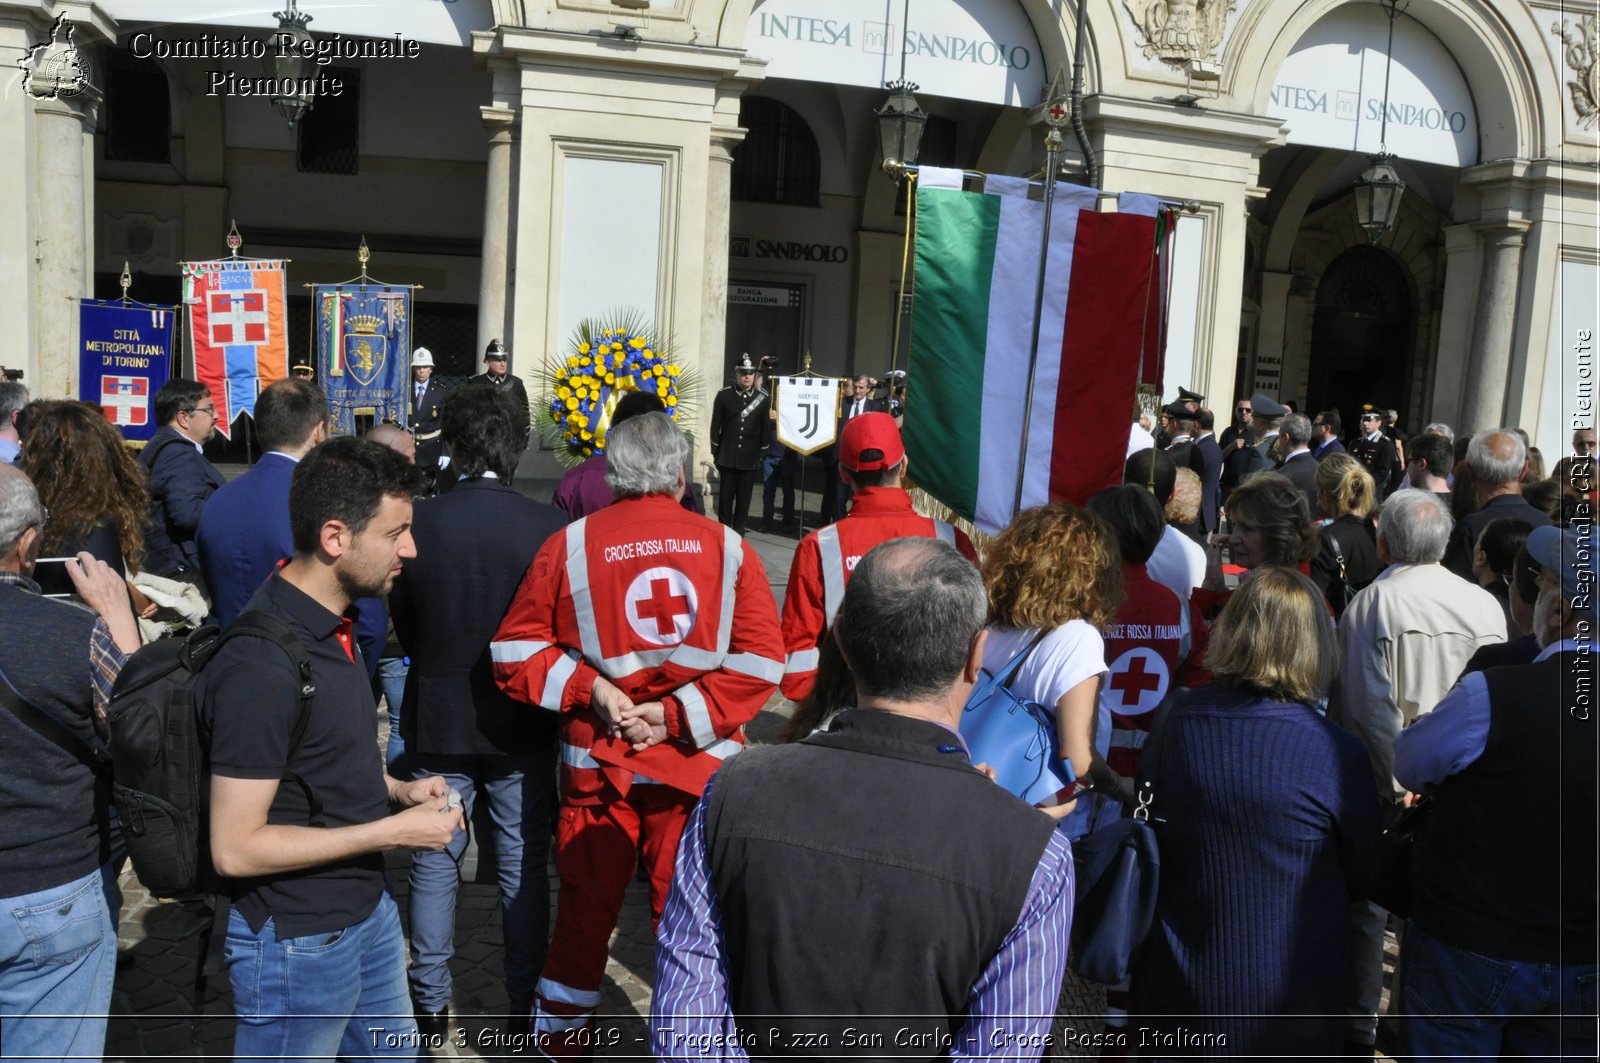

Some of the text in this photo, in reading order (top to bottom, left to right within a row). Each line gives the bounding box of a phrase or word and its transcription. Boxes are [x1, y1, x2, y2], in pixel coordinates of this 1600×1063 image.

[760, 12, 1031, 71] INTESA SANPAOLO
[1270, 85, 1466, 134] NTESA SANPAOLO
[756, 239, 849, 264] SANPAOLO
[737, 288, 762, 296] BANCA
[113, 328, 140, 341] CITTÀ
[86, 340, 165, 356] METROPOLITANA
[102, 355, 150, 368] DI TORINO
[604, 538, 703, 563] CROCE ROSSA ITALIANA
[1127, 624, 1152, 640] ROSSA
[1154, 624, 1181, 640] ITALIANA
